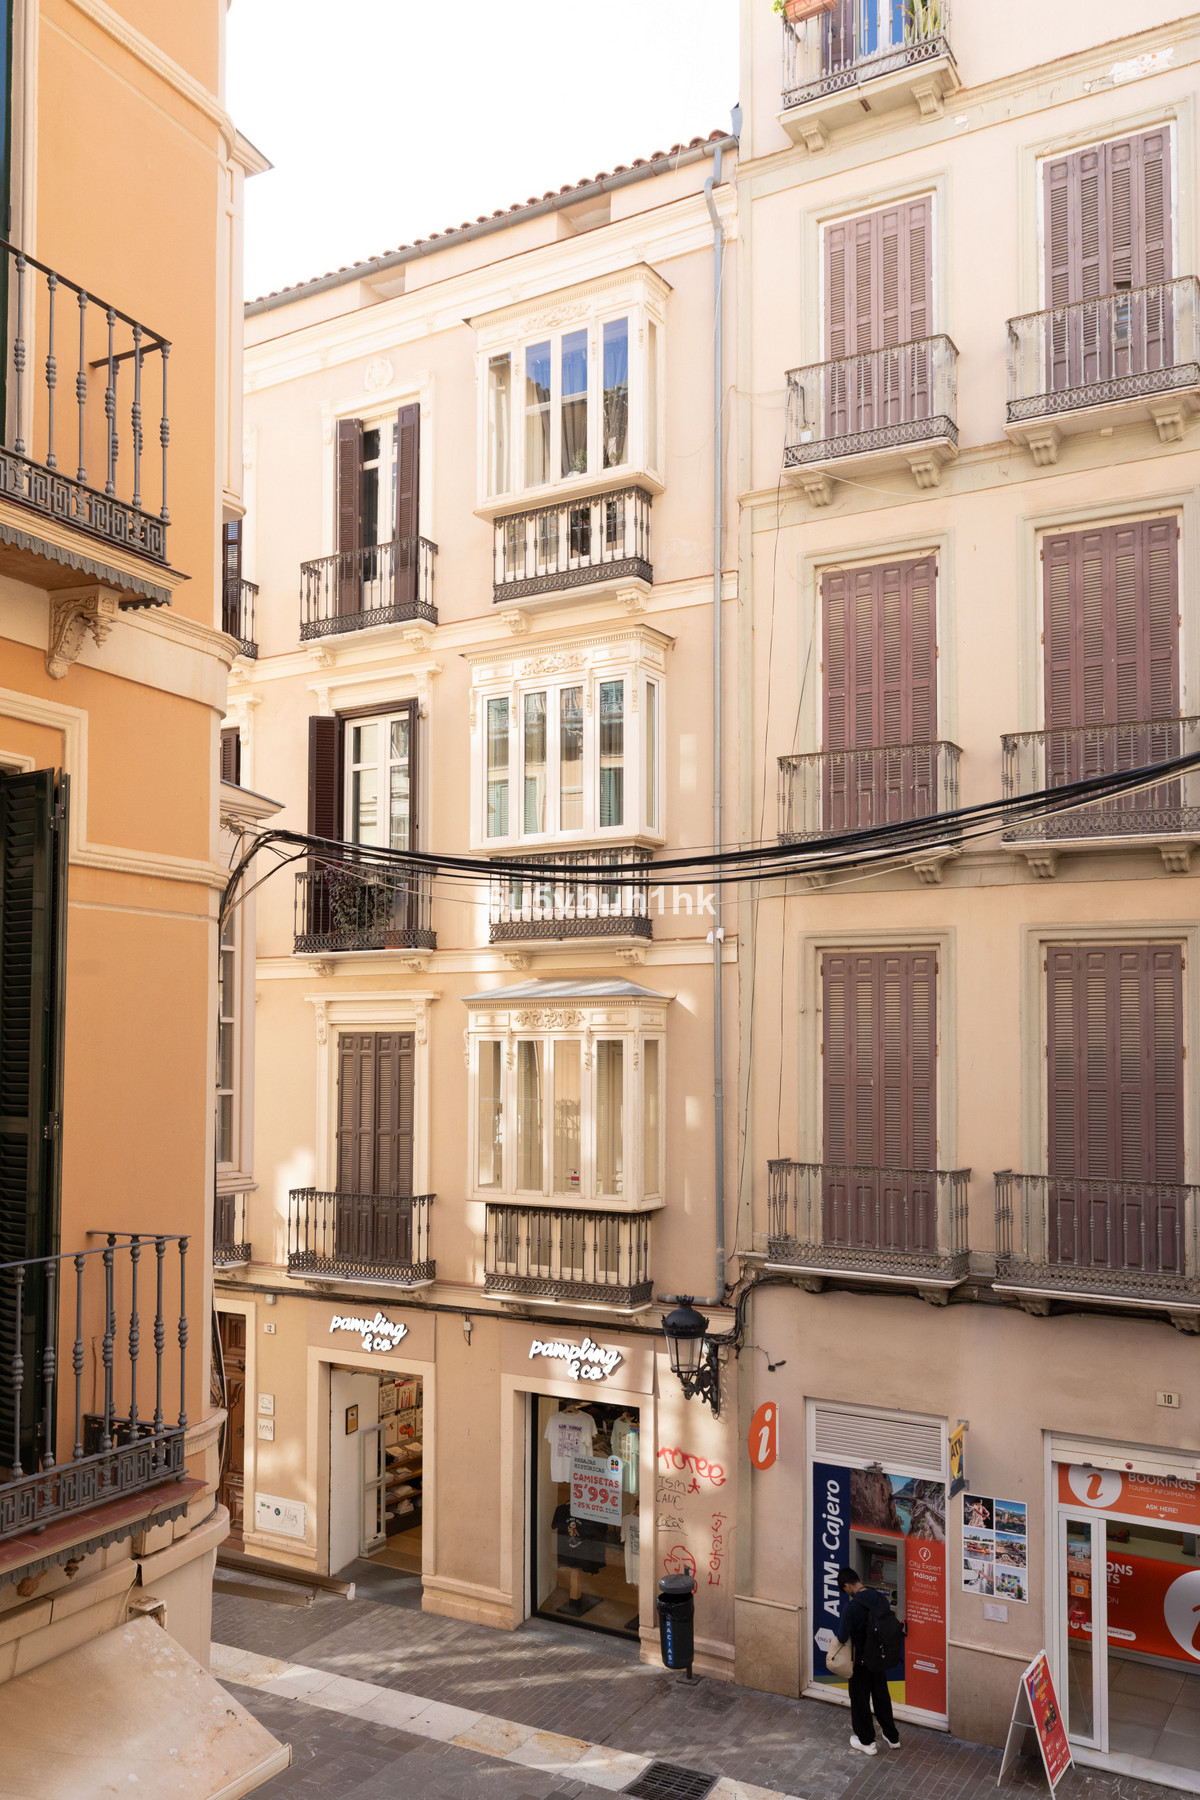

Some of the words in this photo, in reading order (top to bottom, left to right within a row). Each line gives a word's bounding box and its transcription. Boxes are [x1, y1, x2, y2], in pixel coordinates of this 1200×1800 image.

[329, 1312, 409, 1346] pampling
[528, 1337, 622, 1374] pampling
[1162, 1394, 1173, 1405] 10
[573, 1472, 620, 1489] CAMISETAS
[1128, 1472, 1196, 1491] BOOKINGS
[1129, 1484, 1153, 1493] TOURIST
[1154, 1488, 1196, 1500] INFORMATION
[591, 1504, 605, 1513] DTO.
[822, 1479, 844, 1551] Cajero
[1145, 1503, 1158, 1511] ASK
[1159, 1505, 1179, 1514] HERE!
[908, 1560, 921, 1569] City
[921, 1563, 942, 1572] Expert
[913, 1571, 937, 1582] Málaga
[824, 1561, 840, 1618] ATM
